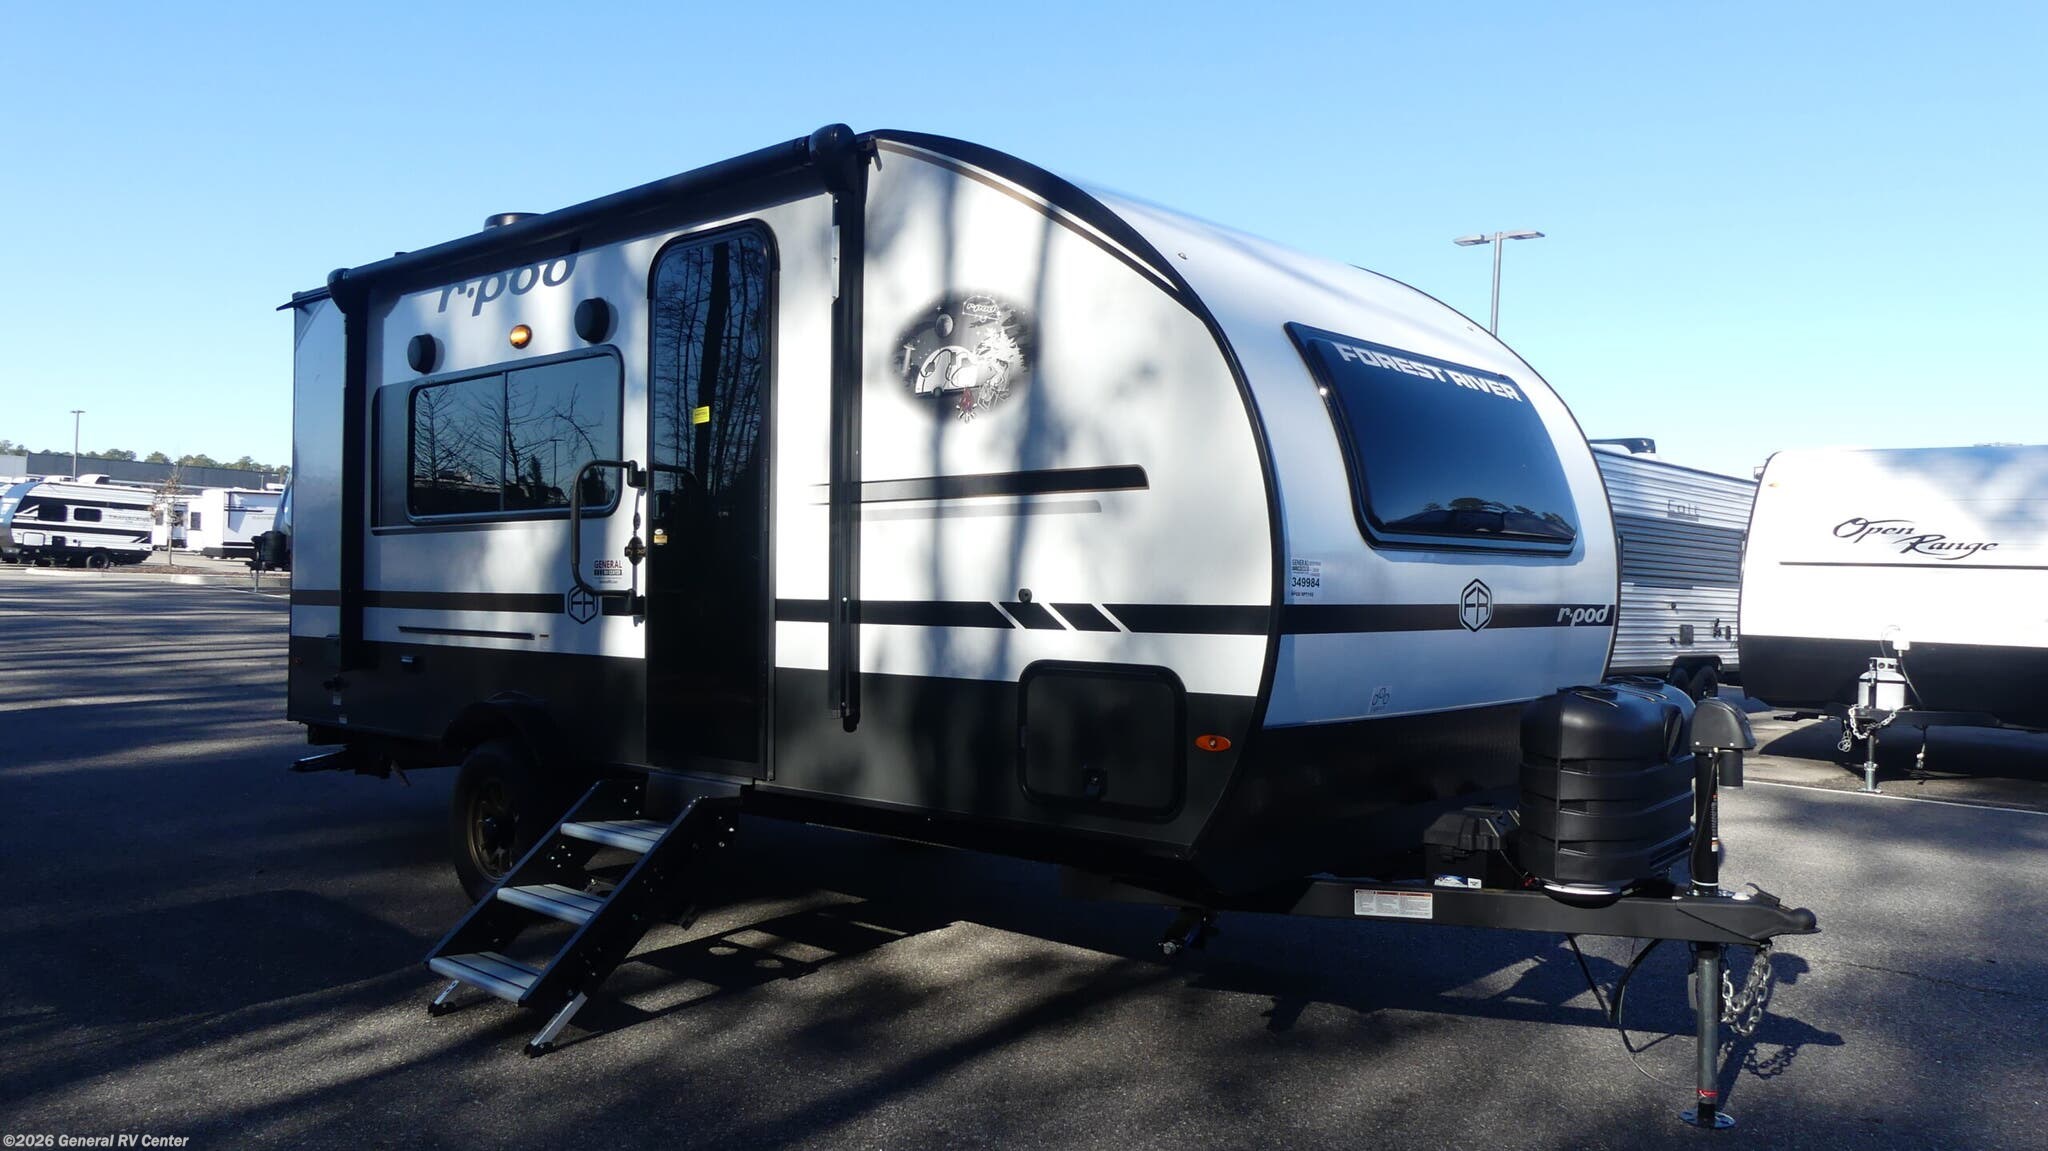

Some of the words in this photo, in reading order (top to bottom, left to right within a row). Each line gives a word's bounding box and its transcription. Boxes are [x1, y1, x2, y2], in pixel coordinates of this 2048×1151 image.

[1332, 341, 1447, 383] FOREST
[1444, 369, 1523, 402] RIVER
[1833, 517, 1915, 544] Open
[1892, 534, 1999, 561] Range
[593, 560, 622, 569] GENERAL
[1291, 577, 1320, 588] 349984
